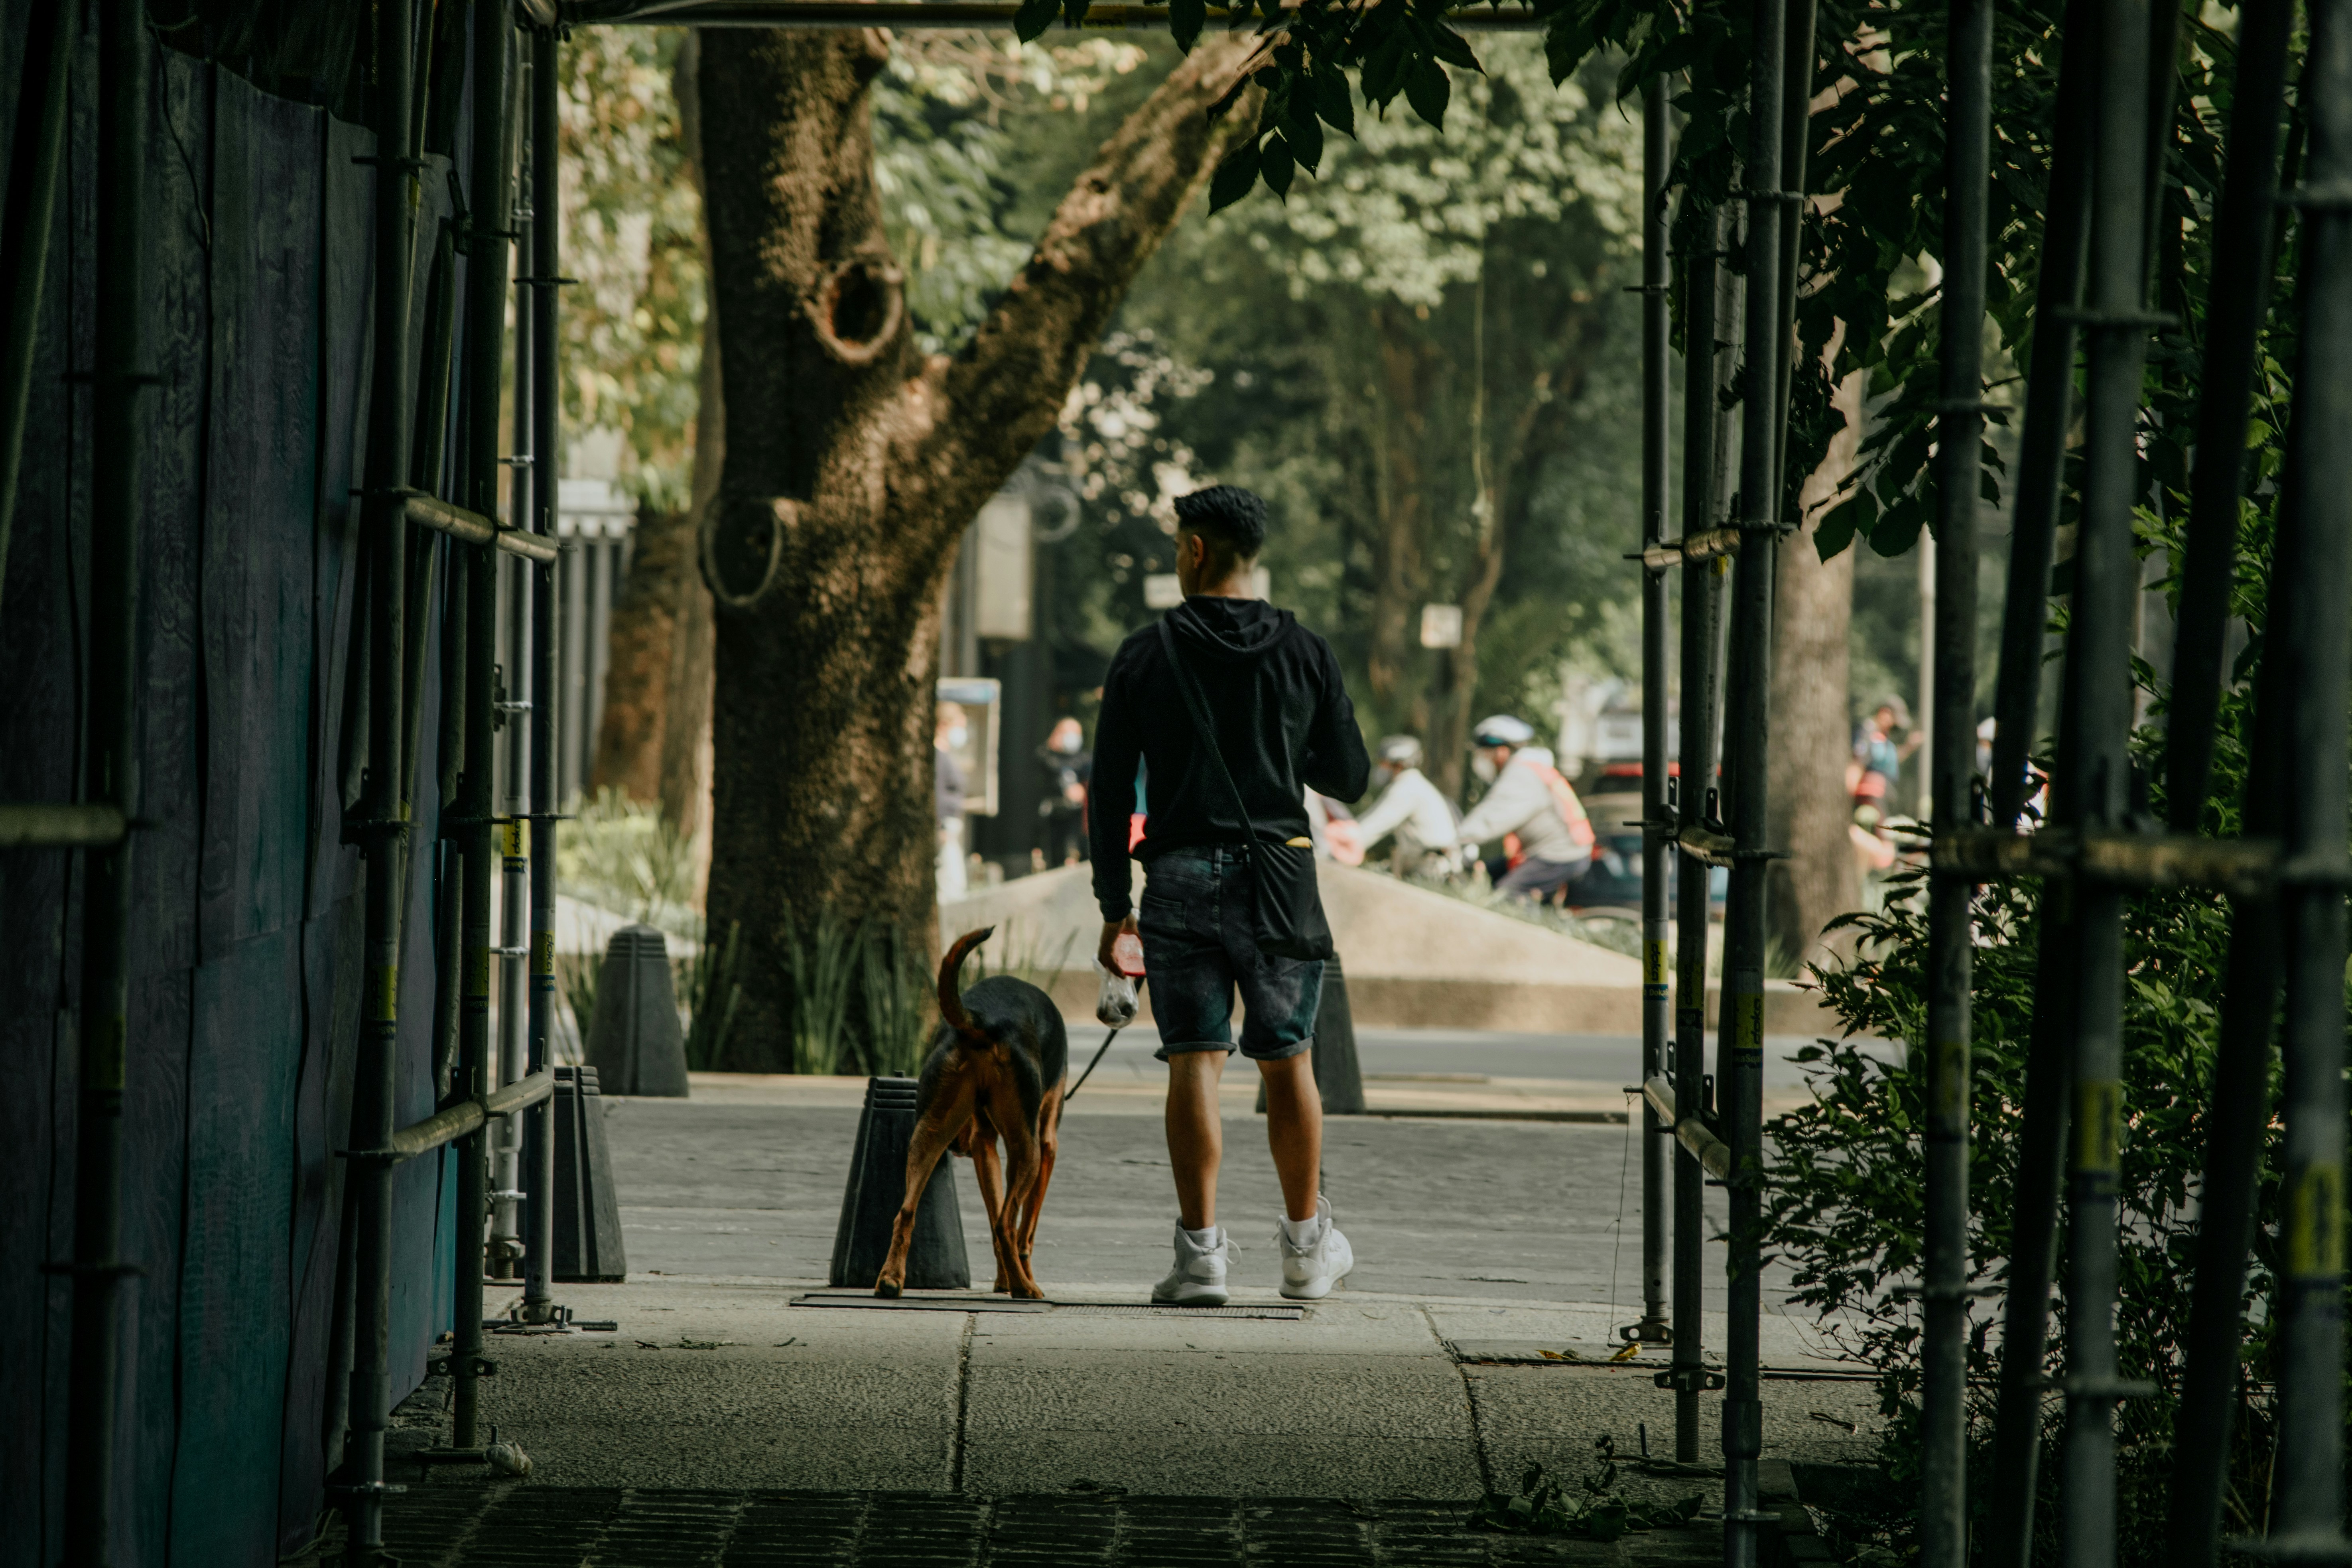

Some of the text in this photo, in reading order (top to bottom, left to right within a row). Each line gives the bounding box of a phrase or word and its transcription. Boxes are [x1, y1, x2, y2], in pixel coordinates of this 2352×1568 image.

[1651, 944, 1661, 981] doka
[1682, 964, 1693, 1006] doka
[1750, 998, 1761, 1044] doka
